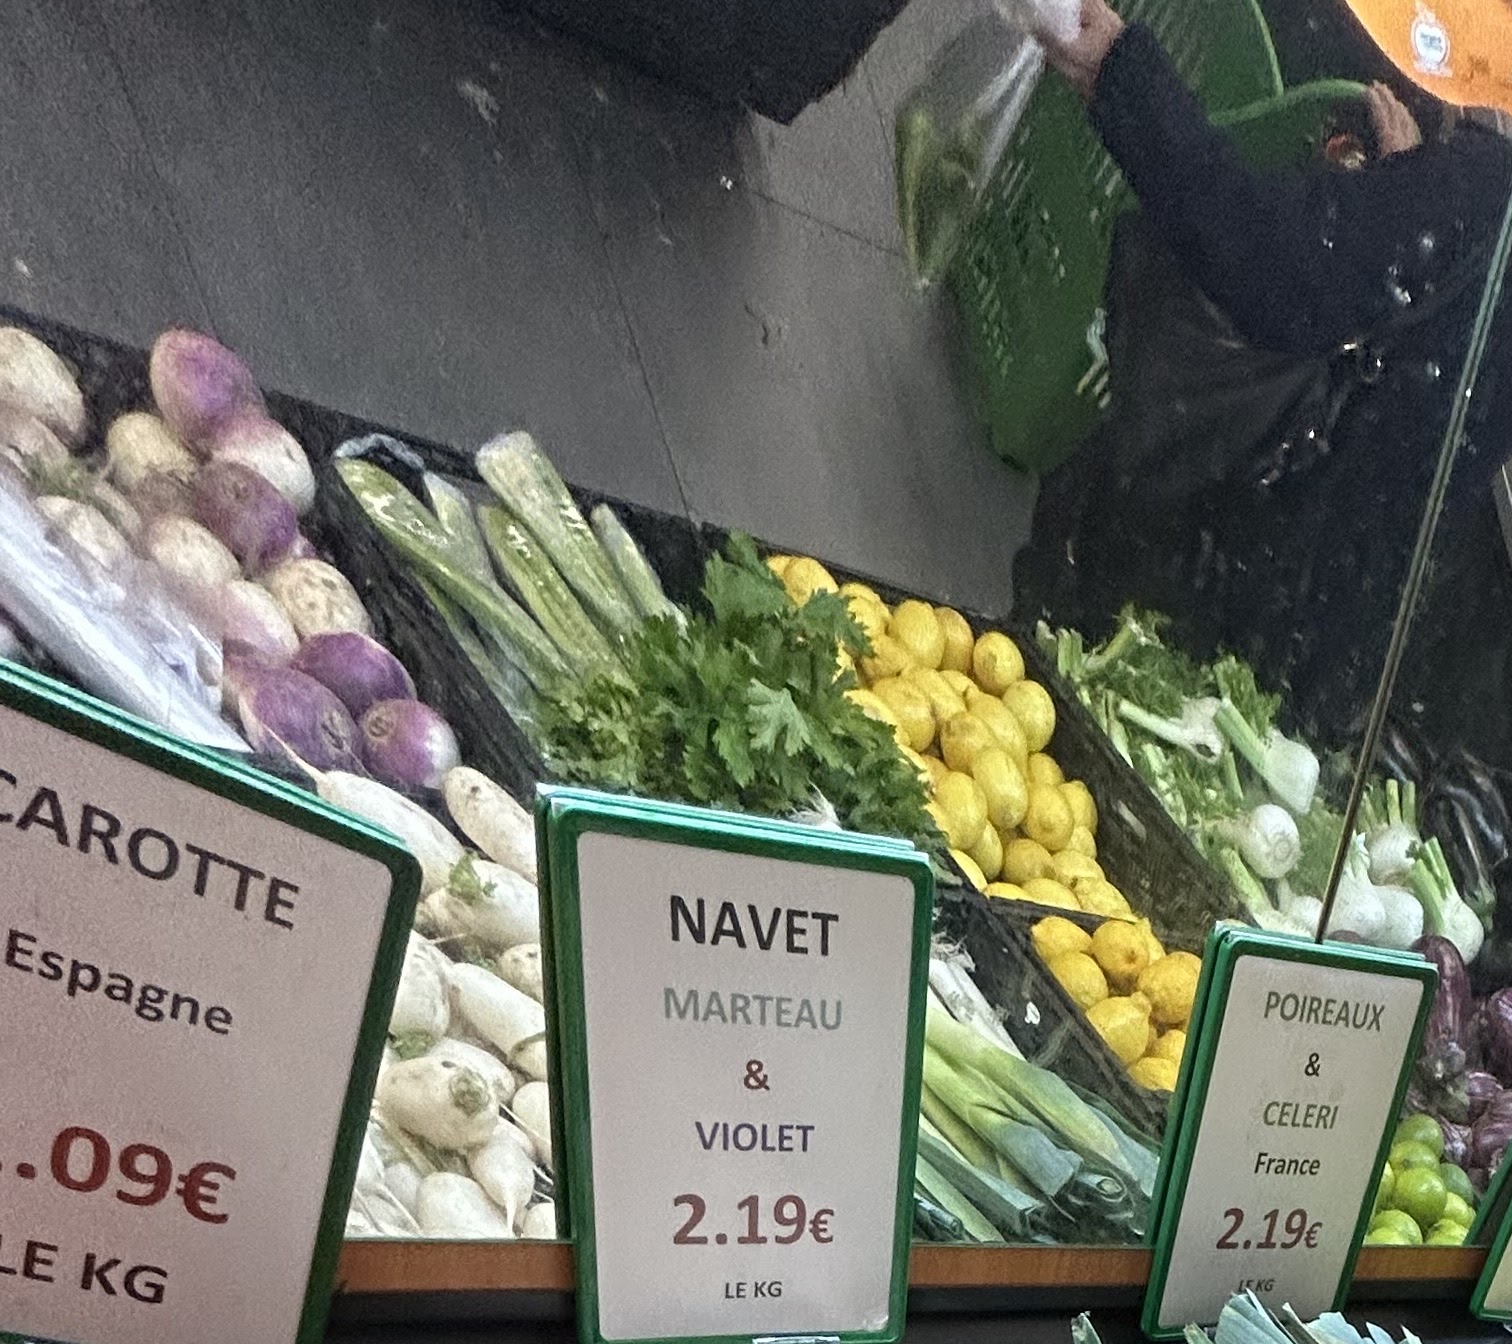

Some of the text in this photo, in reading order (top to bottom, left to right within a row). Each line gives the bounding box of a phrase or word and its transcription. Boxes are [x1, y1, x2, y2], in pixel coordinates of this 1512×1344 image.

[669, 894, 840, 957] NAVET
[4, 928, 234, 1036] Espagne
[662, 986, 844, 1030] MARTEAU
[1263, 990, 1386, 1032] POIREAUX
[742, 1058, 771, 1092] &
[1304, 1052, 1321, 1077] &
[1262, 1100, 1339, 1130] CELERI
[694, 1120, 816, 1153] VIOLET
[0, 1126, 237, 1225] .09€
[1253, 1151, 1321, 1177] France
[672, 1193, 835, 1246] 2.19€
[1215, 1207, 1323, 1250] 2.19€
[80, 1252, 169, 1305] KG
[723, 1280, 783, 1301] LE KG
[1255, 1278, 1275, 1293] KG
